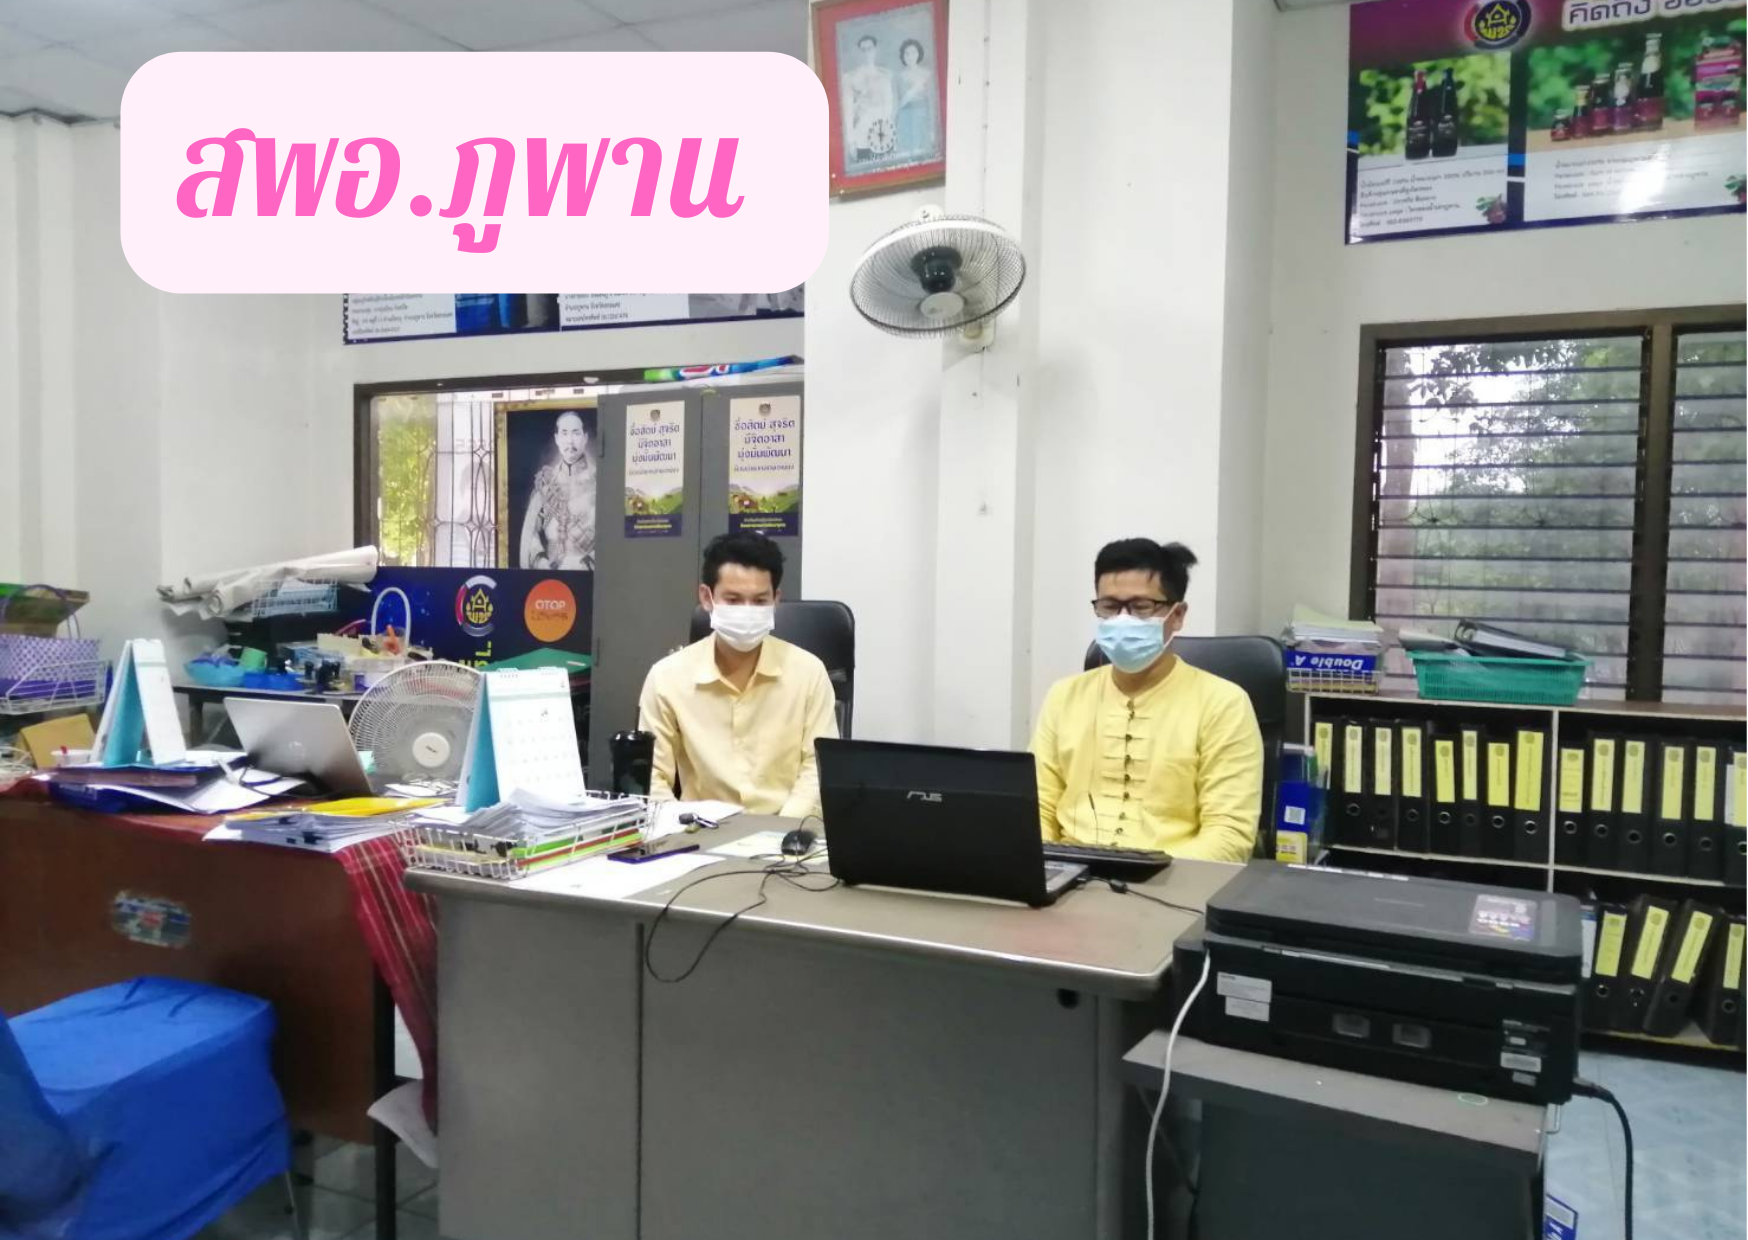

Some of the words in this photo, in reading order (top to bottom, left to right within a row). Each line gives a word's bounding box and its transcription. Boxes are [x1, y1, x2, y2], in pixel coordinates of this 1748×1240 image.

[535, 599, 566, 610] OTOP
[1295, 654, 1307, 666] A
[1310, 656, 1365, 670] Double
